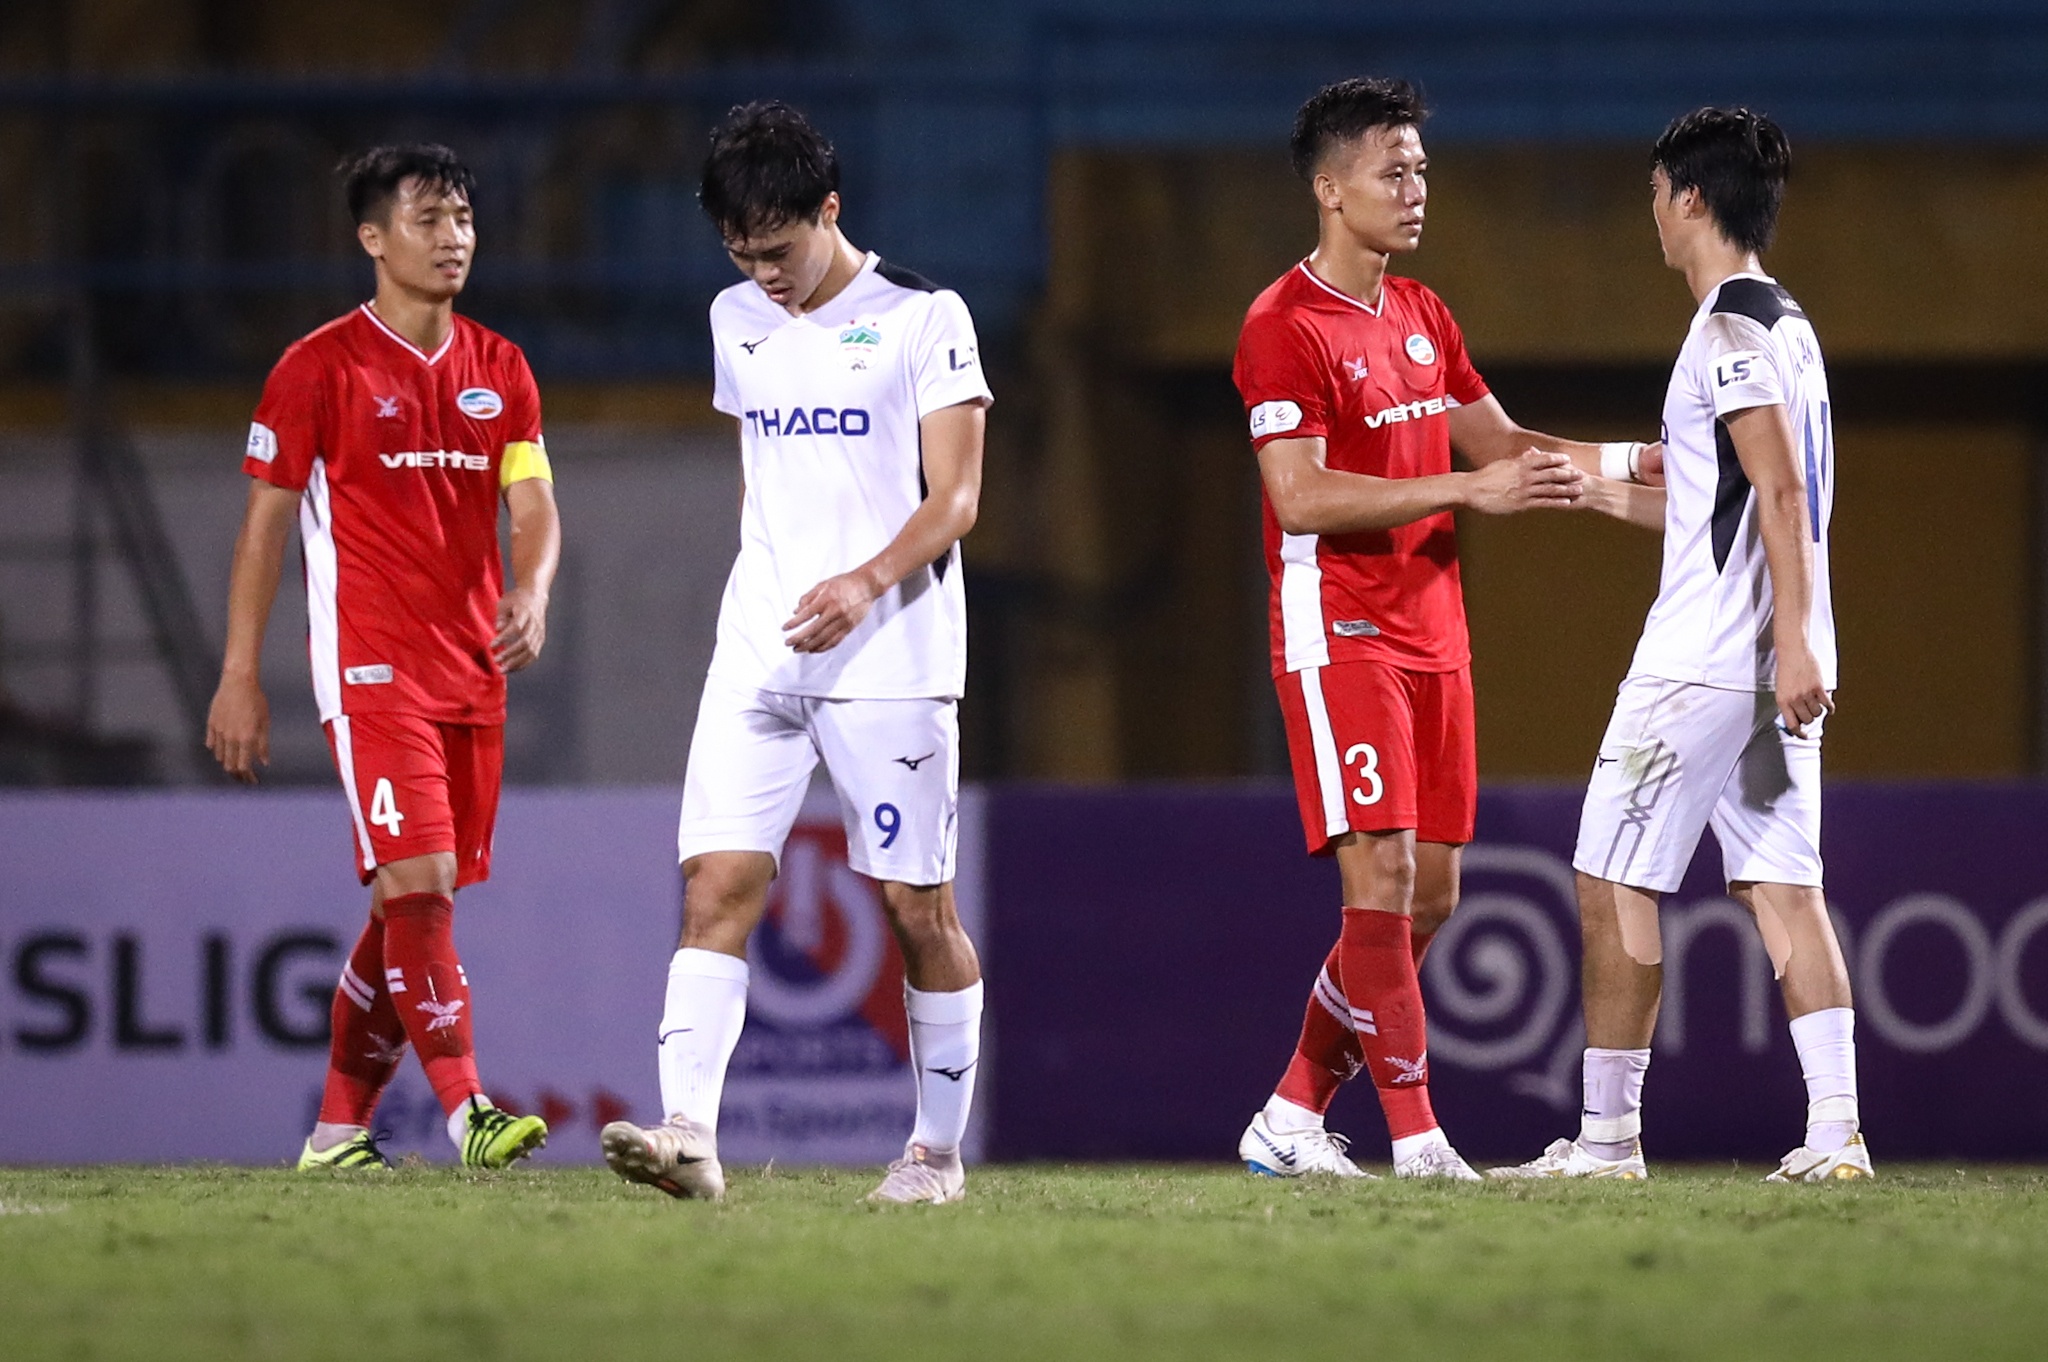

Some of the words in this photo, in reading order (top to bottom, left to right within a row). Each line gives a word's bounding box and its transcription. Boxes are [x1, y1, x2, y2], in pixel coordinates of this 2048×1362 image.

[1716, 359, 1751, 388] LS
[745, 407, 870, 438] THACO
[1344, 742, 1384, 805] 3
[369, 777, 405, 837] 4
[874, 802, 901, 849] 9
